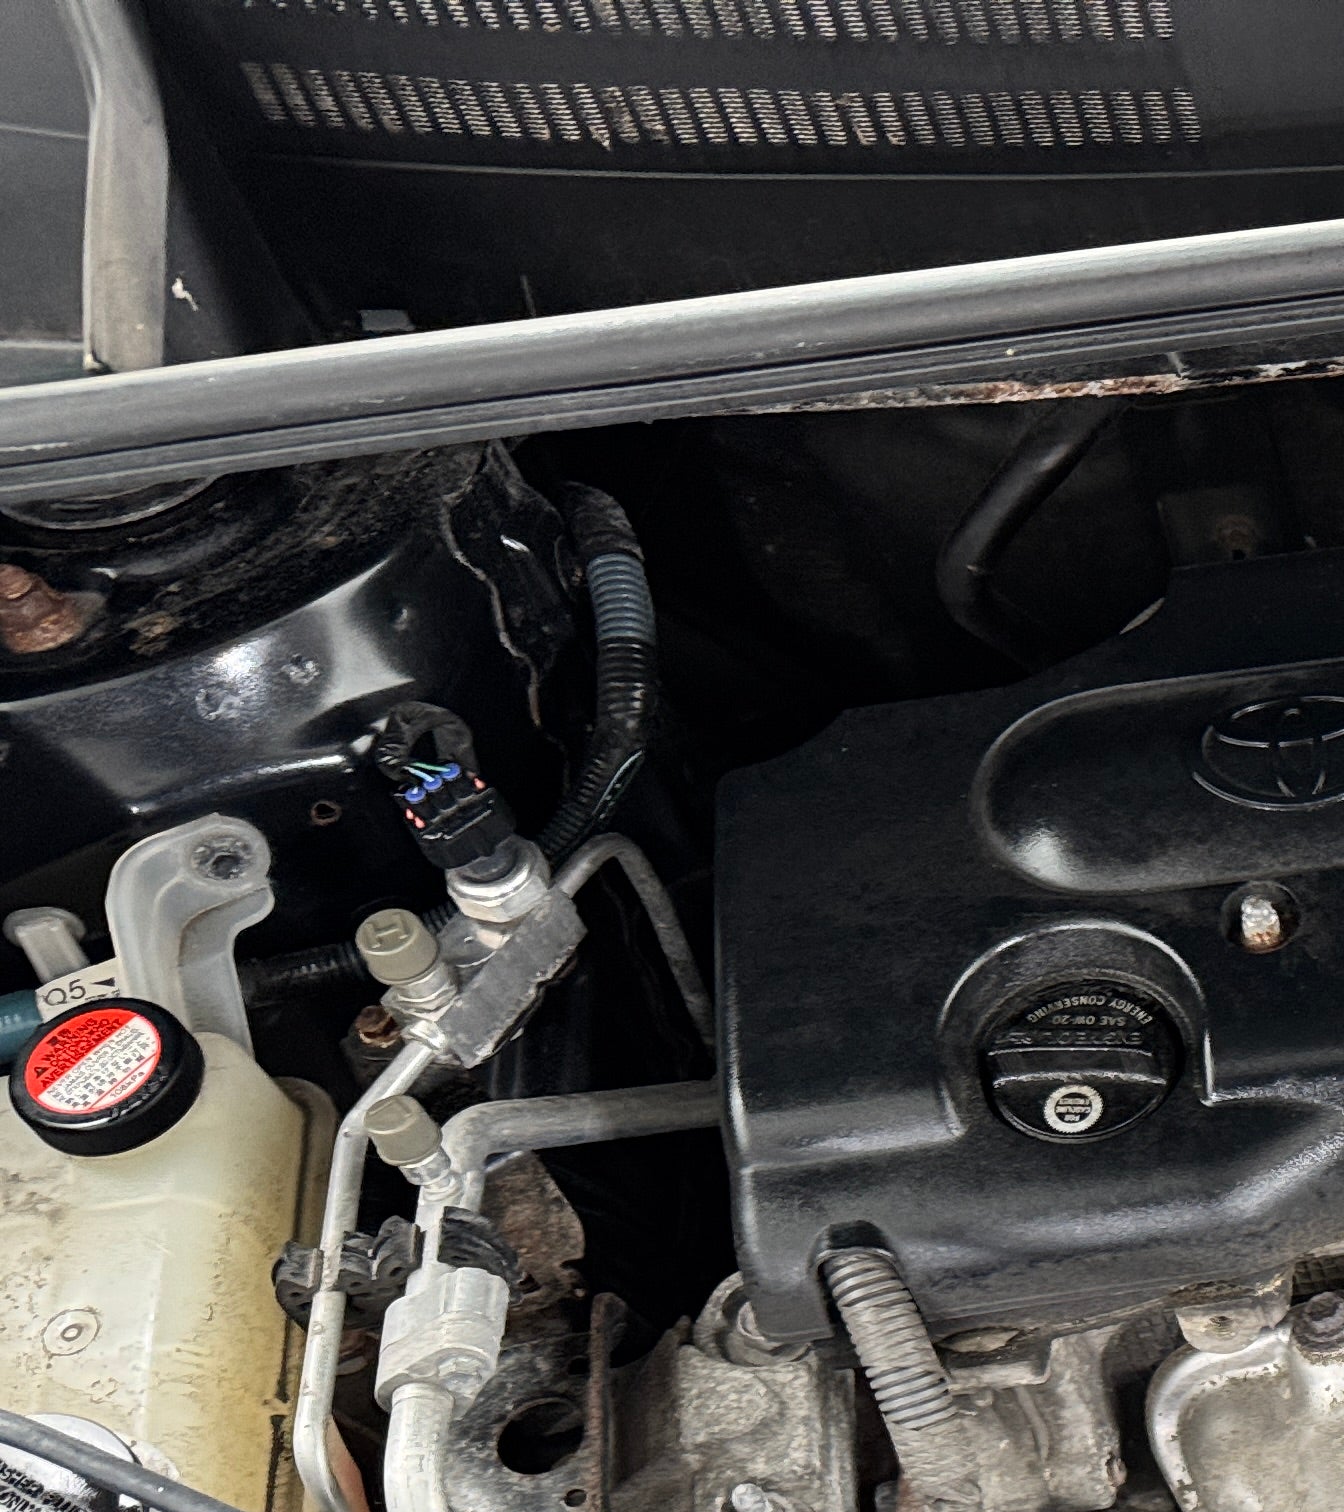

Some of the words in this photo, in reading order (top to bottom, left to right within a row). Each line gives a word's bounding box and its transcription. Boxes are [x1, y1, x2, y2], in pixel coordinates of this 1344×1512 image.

[363, 911, 410, 949] H
[1025, 995, 1105, 1022] CONSERVING
[1099, 1015, 1126, 1025] SAE
[1108, 998, 1152, 1024] ENERGY
[42, 1015, 97, 1063] WARNING
